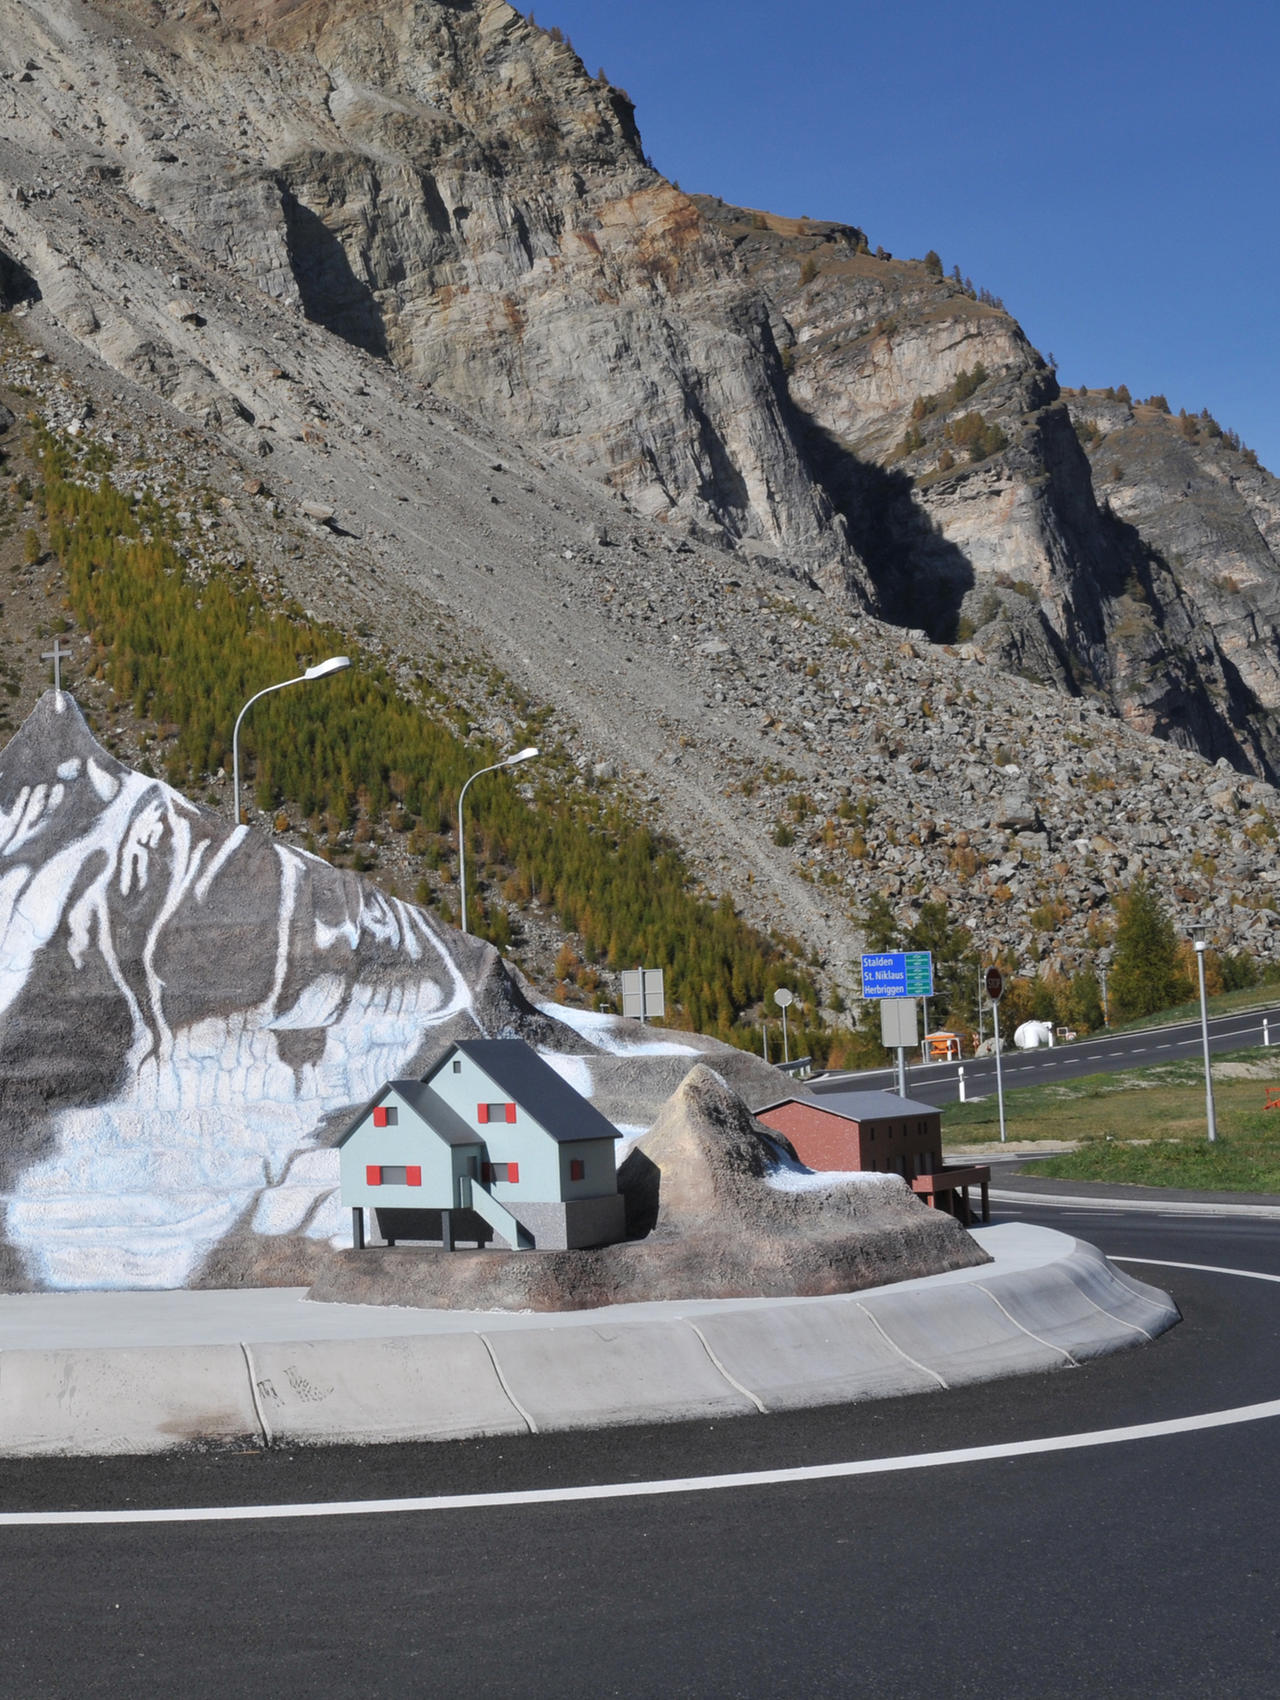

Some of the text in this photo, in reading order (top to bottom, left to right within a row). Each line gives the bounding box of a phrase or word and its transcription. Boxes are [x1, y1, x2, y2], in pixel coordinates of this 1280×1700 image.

[863, 957, 894, 968] Stalden
[864, 971, 874, 982] St.
[875, 969, 904, 981] Niklaus
[988, 978, 1001, 989] STOP
[864, 984, 904, 996] Herbriggen
